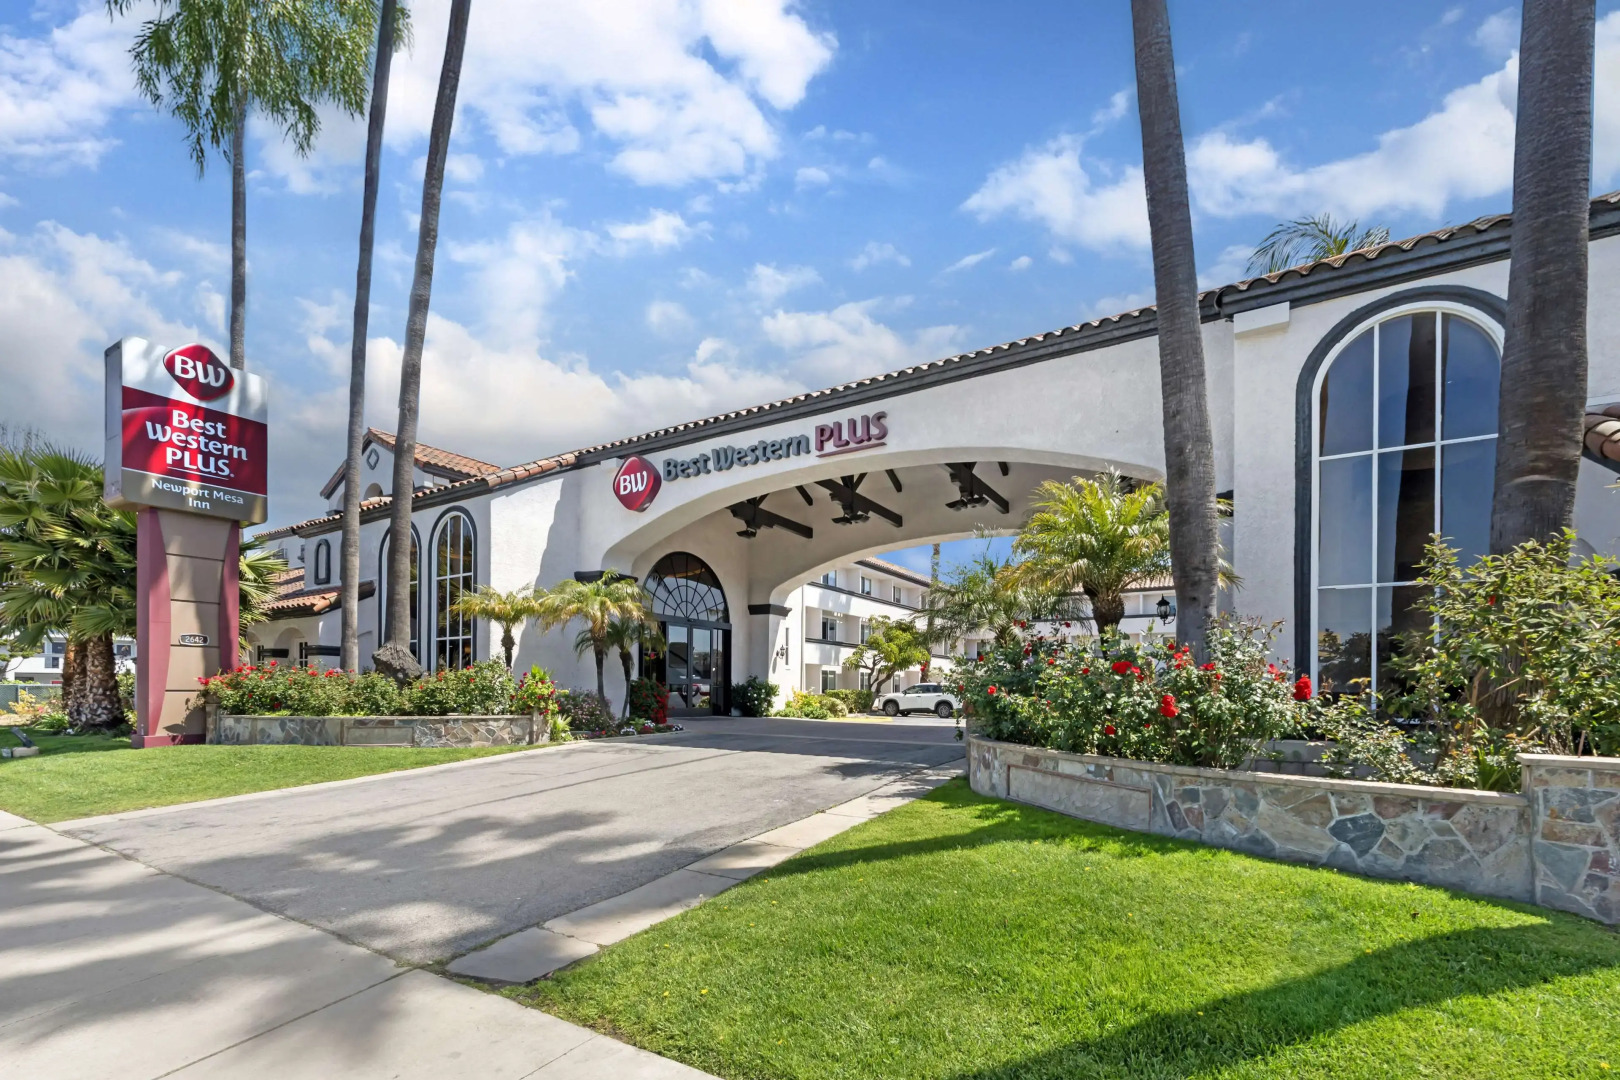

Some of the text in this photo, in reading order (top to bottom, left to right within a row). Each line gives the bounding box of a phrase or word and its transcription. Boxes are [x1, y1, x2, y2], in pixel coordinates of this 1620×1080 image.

[174, 354, 226, 387] BW
[172, 409, 227, 438] Best
[145, 420, 248, 461] Western
[663, 410, 889, 482] Best Western PLUS
[151, 478, 244, 504] Newport Mesa
[619, 470, 648, 495] BW
[188, 497, 210, 510] Inn
[185, 635, 204, 644] 2642
